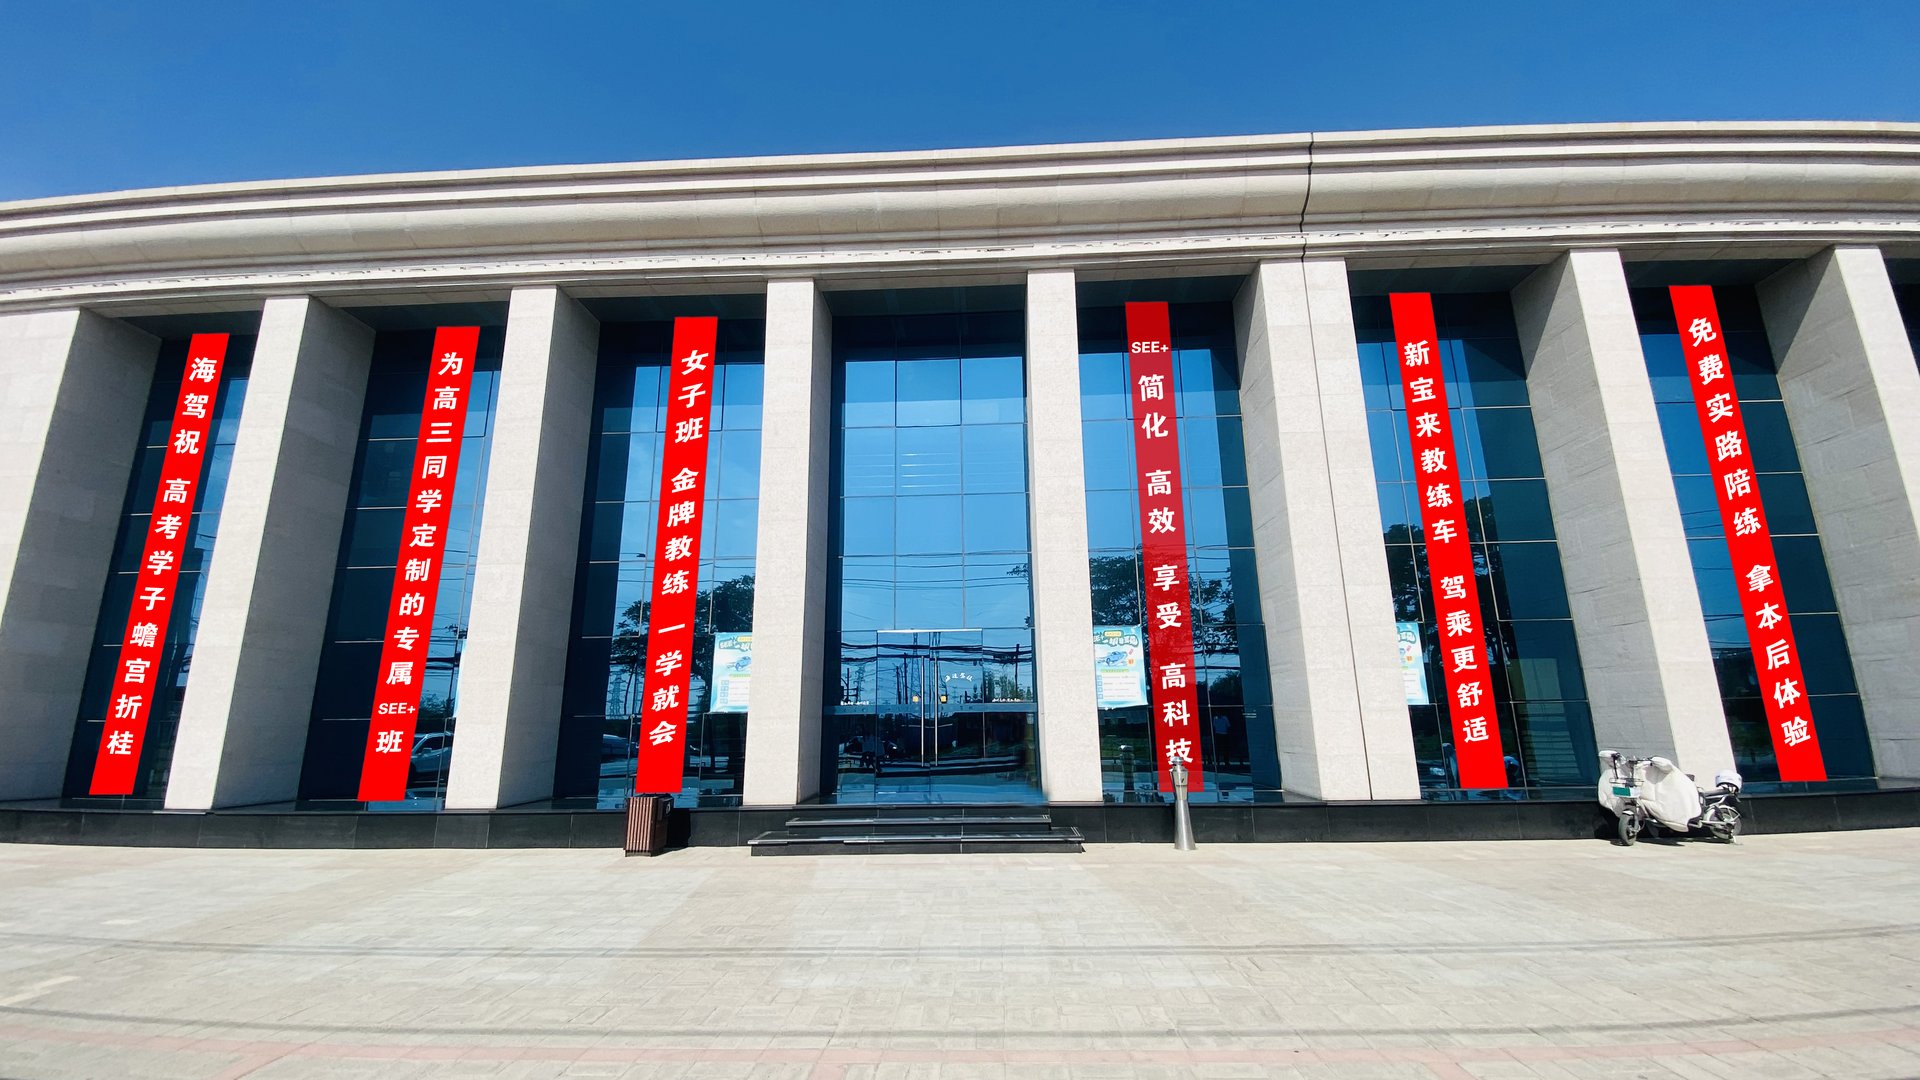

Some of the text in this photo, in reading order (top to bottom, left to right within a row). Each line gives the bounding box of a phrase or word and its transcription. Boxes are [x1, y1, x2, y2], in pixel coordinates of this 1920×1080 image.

[106, 356, 218, 755] 海驾祝 高考学子蟾宫折桂
[649, 349, 709, 746] 女子班 金牌教练 一学就会
[1145, 468, 1177, 534] 高效
[1152, 564, 1182, 630] 享受
[1404, 339, 1489, 743] 新宝来教练车 驾乘更舒适
[1688, 316, 1811, 747] 免费实路陪练 拿本后体验
[1159, 662, 1194, 765] 高科技
